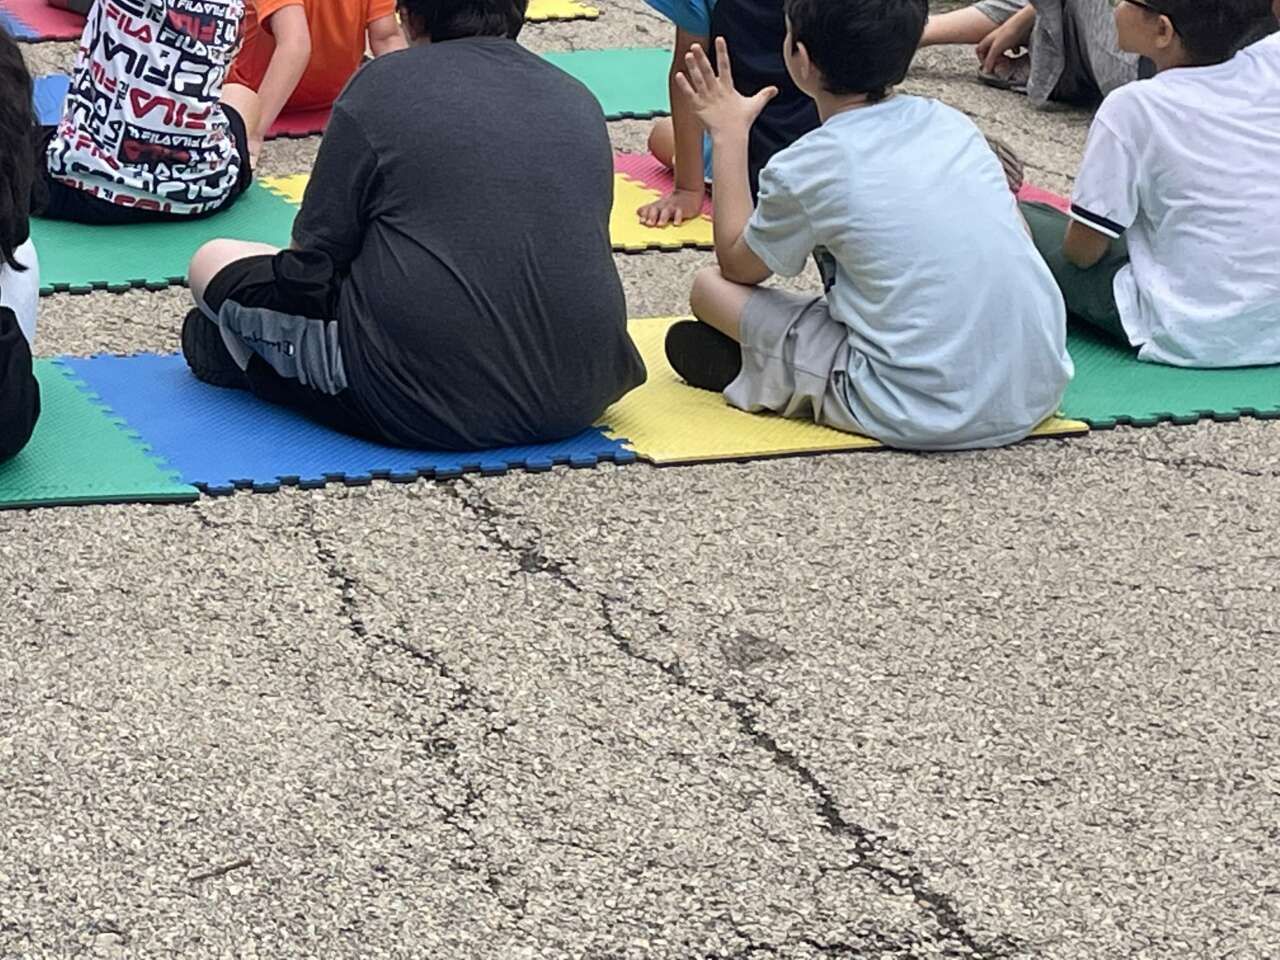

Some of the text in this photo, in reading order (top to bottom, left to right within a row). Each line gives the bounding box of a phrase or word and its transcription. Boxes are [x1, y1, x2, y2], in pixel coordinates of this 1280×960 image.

[106, 2, 153, 44] FILA
[159, 25, 209, 57] FILA
[102, 31, 171, 87] FILA
[129, 87, 211, 129] FILA
